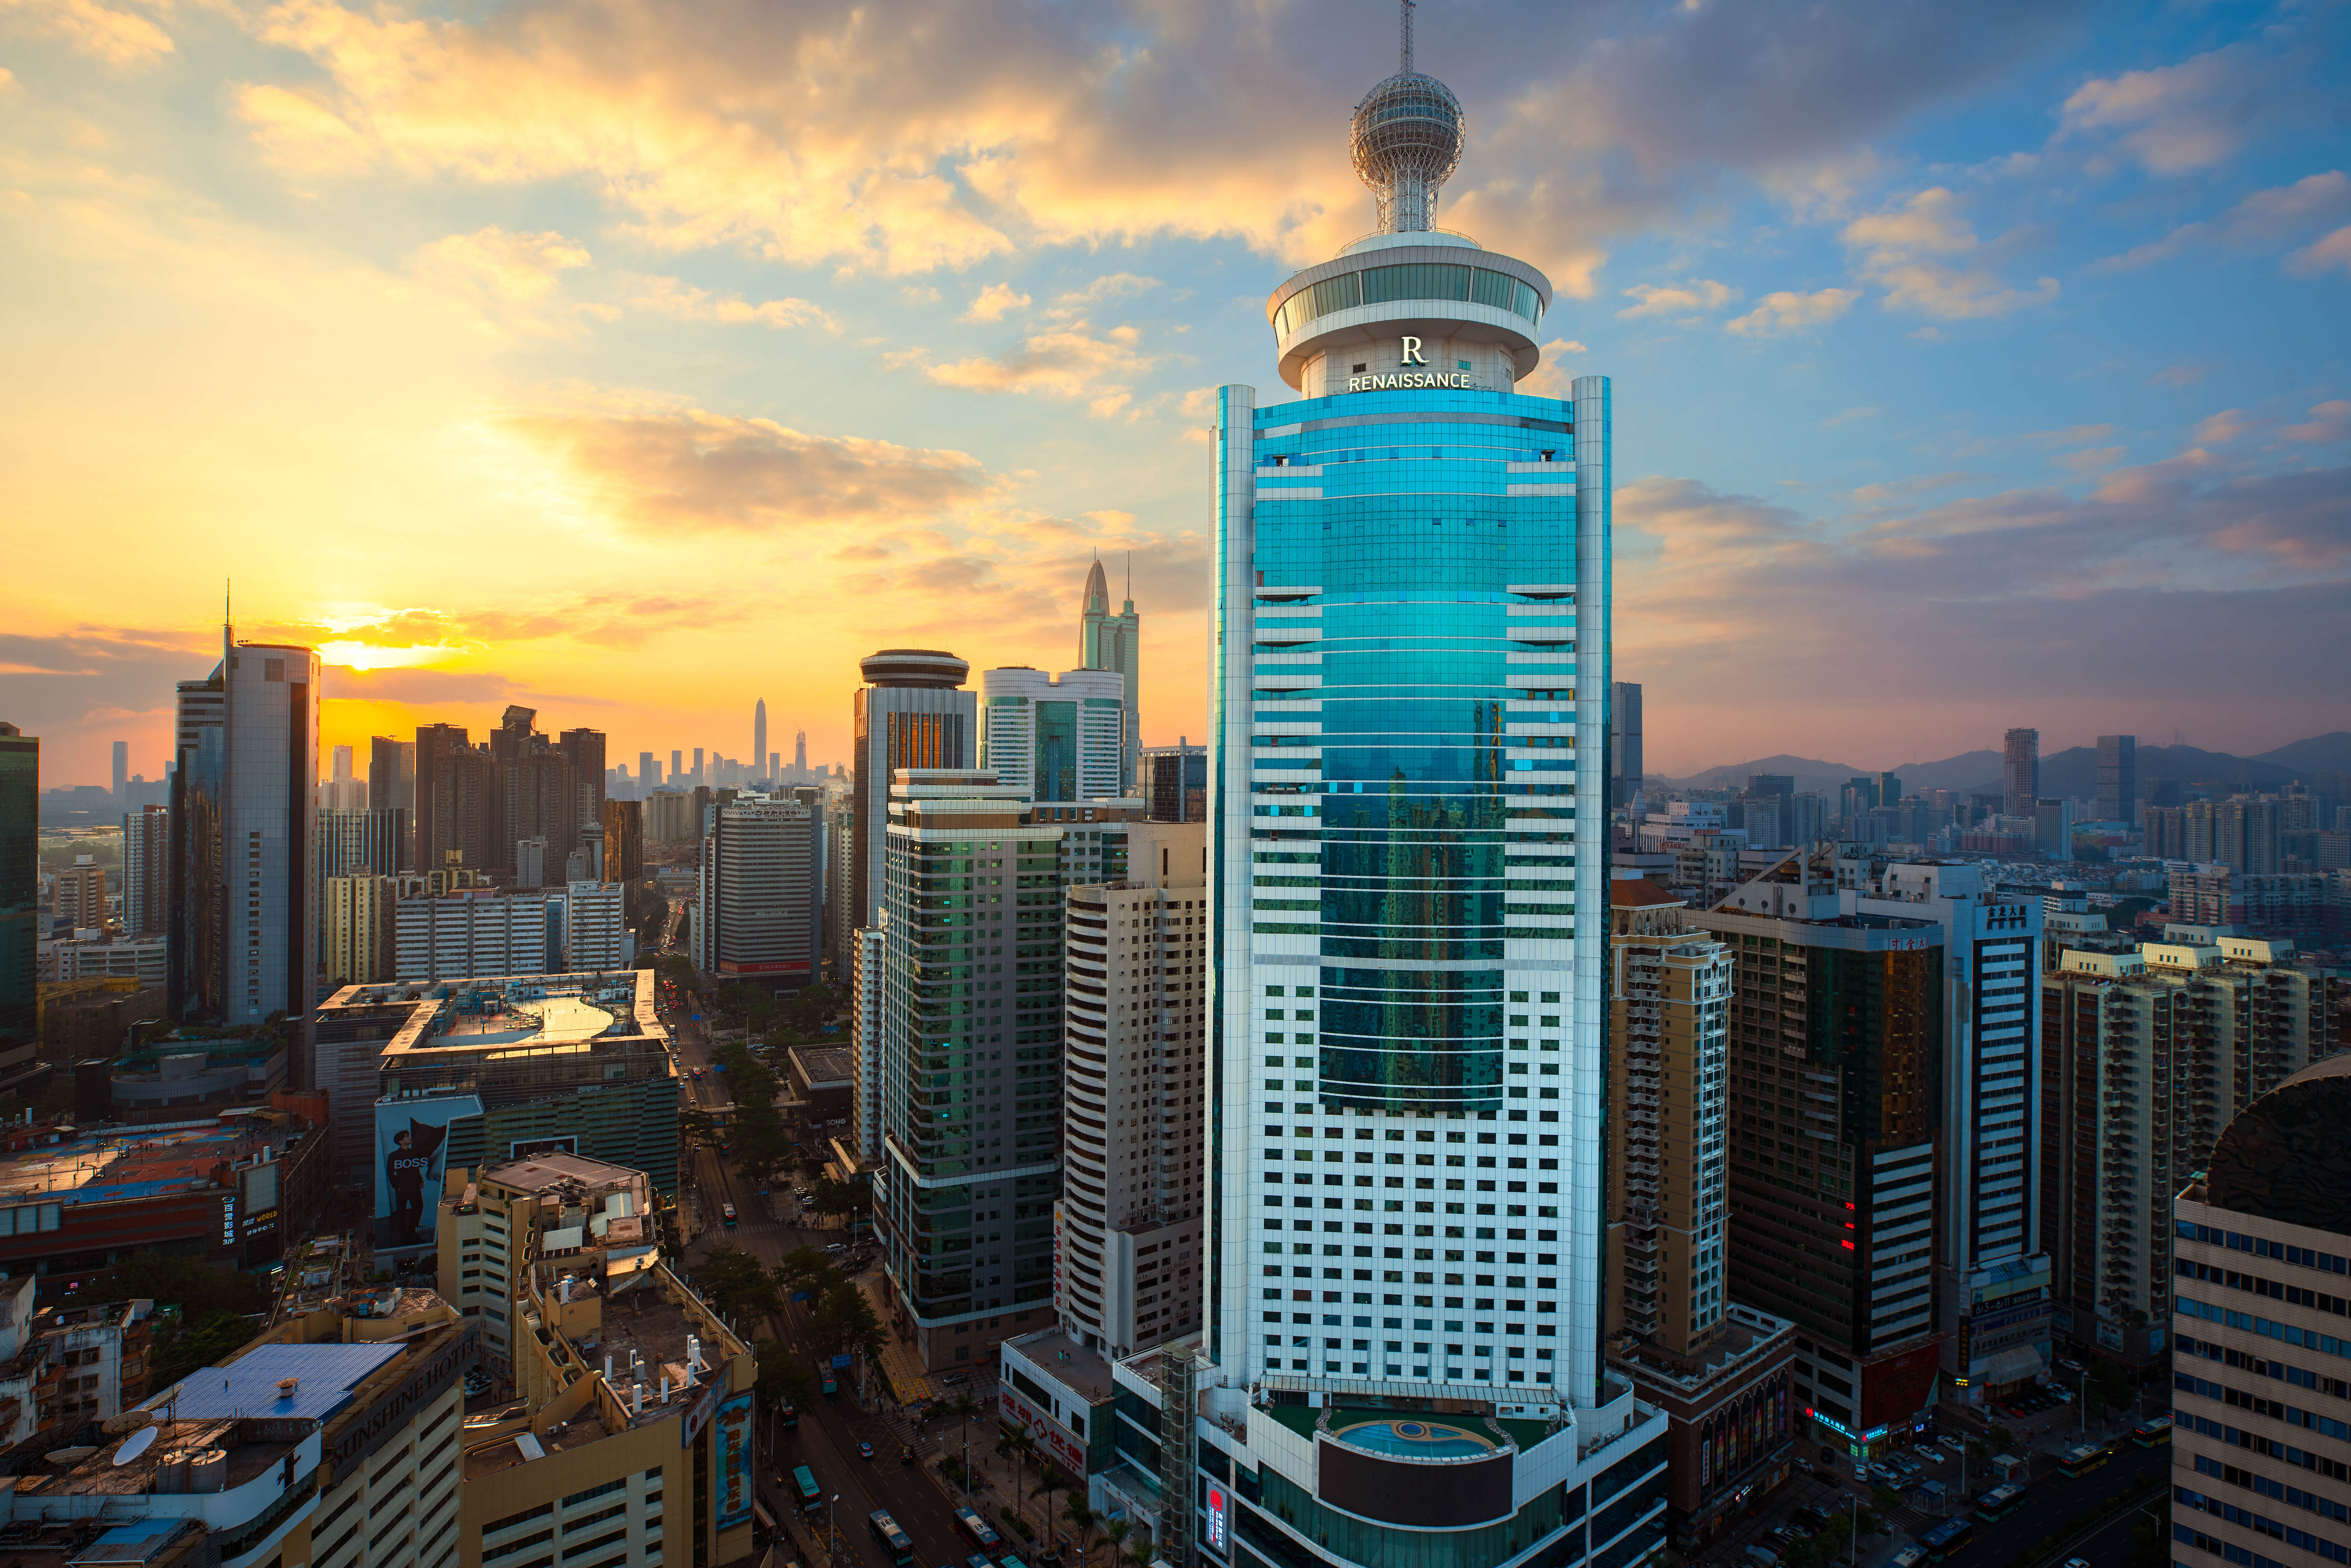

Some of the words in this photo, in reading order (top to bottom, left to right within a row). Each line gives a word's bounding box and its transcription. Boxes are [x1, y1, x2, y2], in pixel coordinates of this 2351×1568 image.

[1401, 336, 1430, 363] R
[1349, 373, 1470, 392] RENAISSANCE
[1988, 905, 2026, 917] 金龙大厦
[1892, 937, 1929, 950] 寸金大
[394, 1157, 428, 1169] BOSS
[224, 1204, 234, 1238] 百誉影城
[256, 1211, 277, 1222] WORLD
[333, 1378, 424, 1467] SUNSHINE
[427, 1334, 479, 1388] HOTEL
